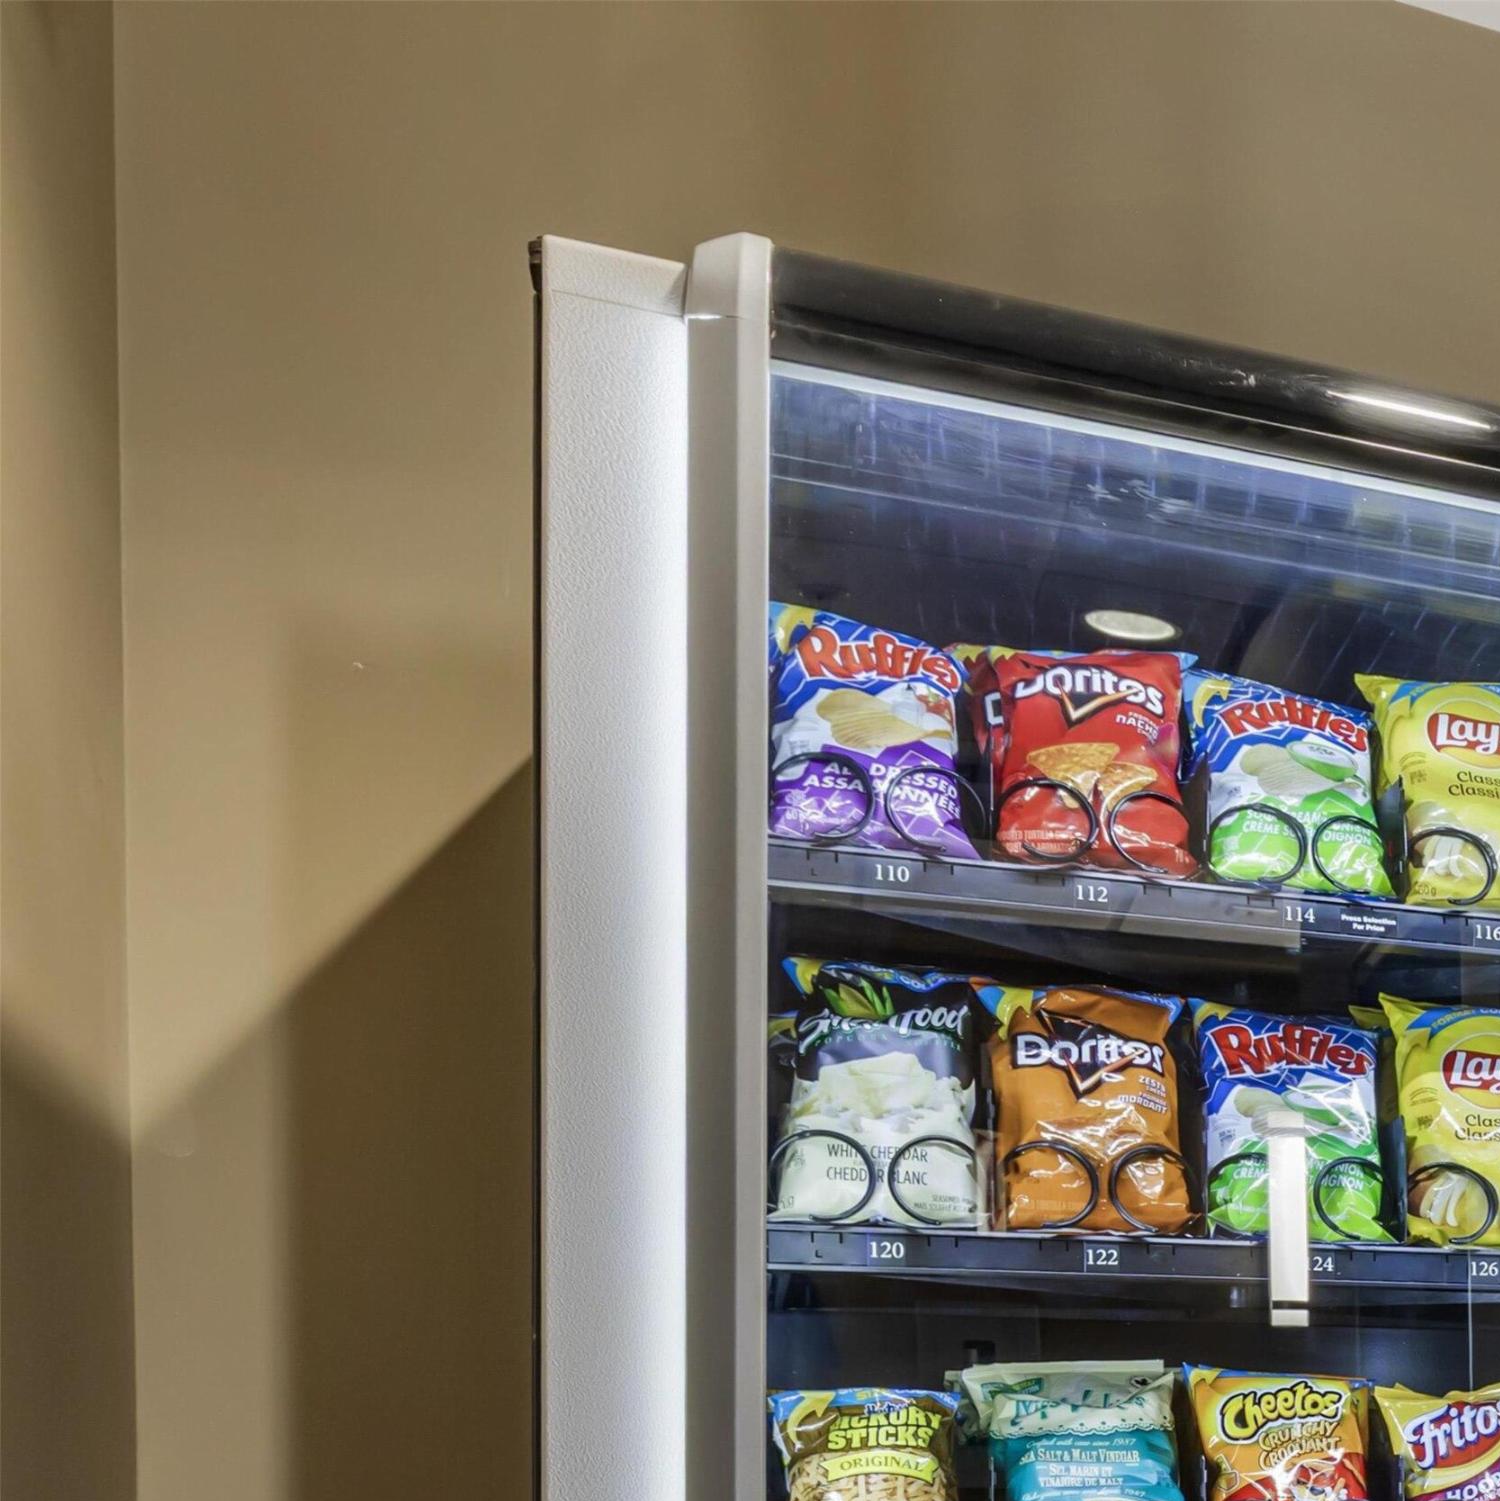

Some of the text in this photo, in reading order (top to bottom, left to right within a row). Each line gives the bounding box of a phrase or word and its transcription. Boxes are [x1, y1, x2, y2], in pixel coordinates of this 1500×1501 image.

[796, 627, 960, 693] Ruffles
[1219, 697, 1369, 752] Ruffles
[874, 863, 911, 882] 110
[1076, 884, 1109, 903] 112
[1285, 905, 1316, 924] 114
[1017, 1033, 1165, 1075] Doritos
[1210, 1023, 1377, 1078] Ruffles
[826, 1166, 885, 1183] CHEDDR
[868, 1240, 905, 1259] 120
[1086, 1248, 1120, 1266] 122
[1304, 1255, 1335, 1272] 24
[1470, 1261, 1500, 1278] 126
[1222, 1381, 1343, 1441] Cheetos
[828, 1426, 935, 1450] STICKS
[840, 1455, 925, 1473] ORIGINAL
[1038, 1448, 1063, 1462] SALT
